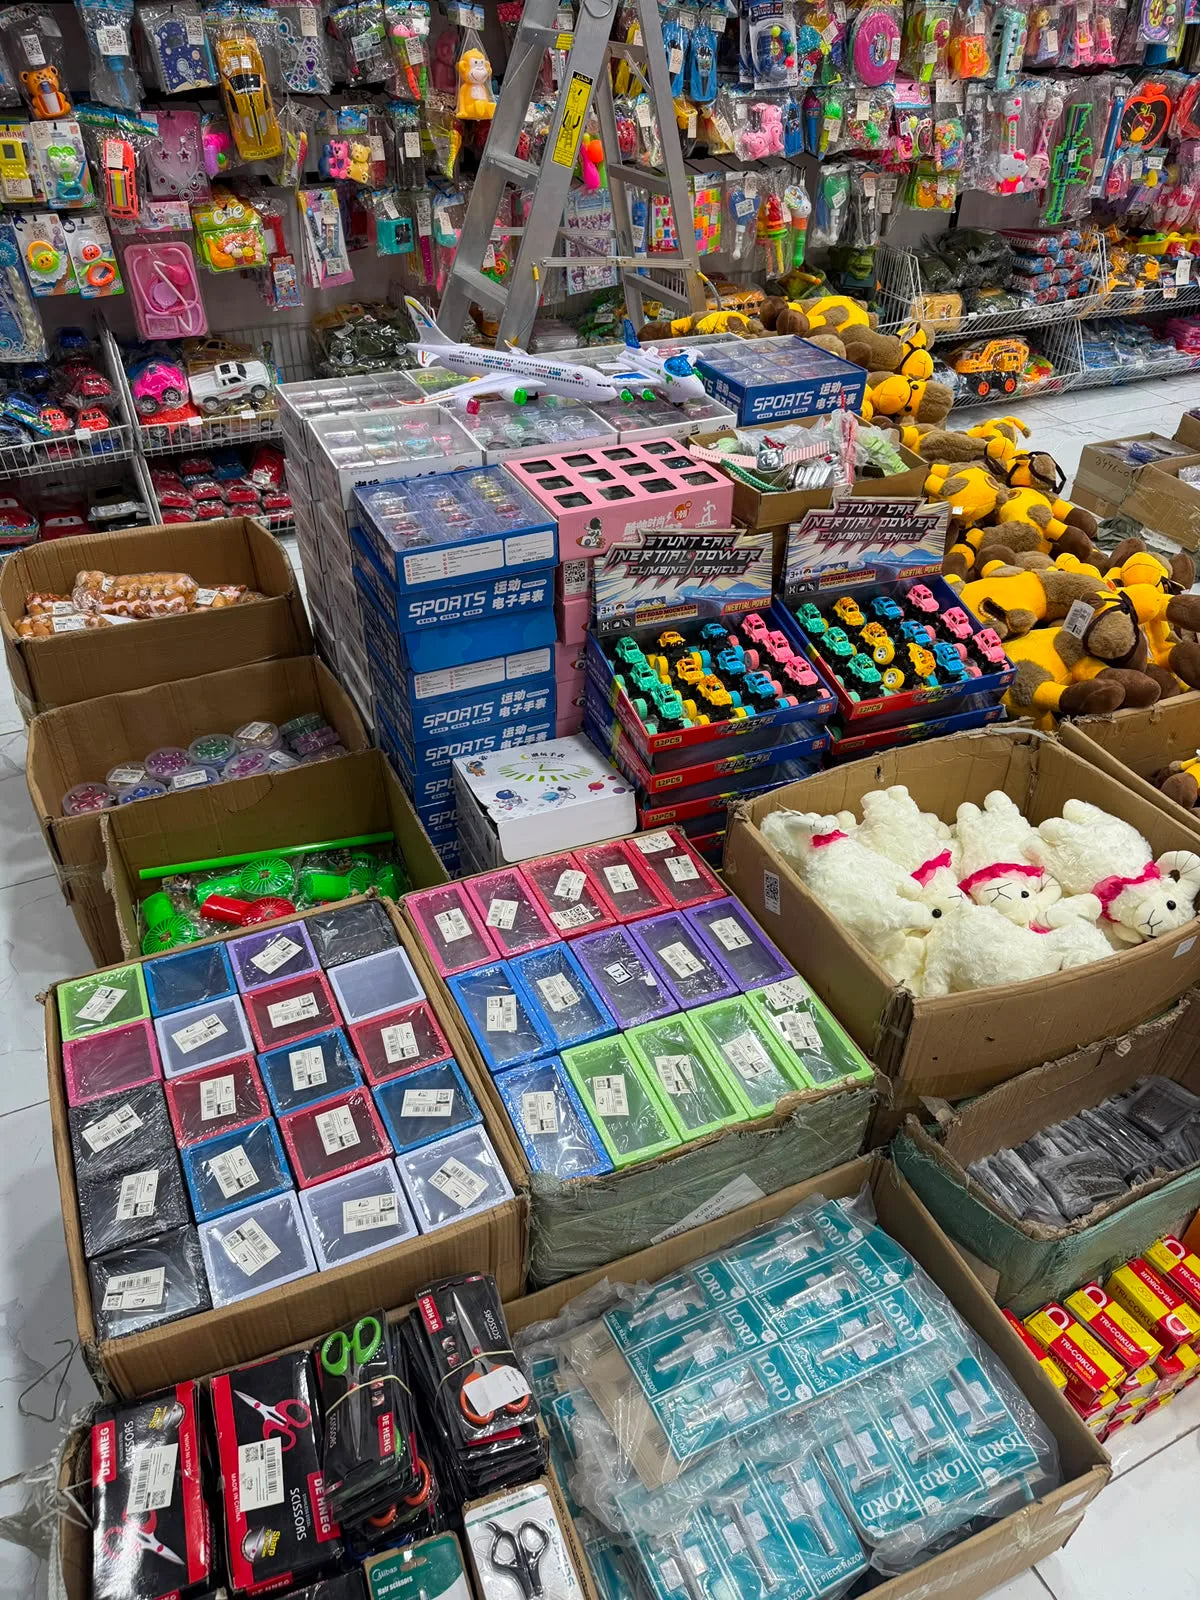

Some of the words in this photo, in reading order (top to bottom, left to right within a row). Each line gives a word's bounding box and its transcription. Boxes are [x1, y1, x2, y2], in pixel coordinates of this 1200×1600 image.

[752, 391, 815, 412] SPORTS
[819, 381, 843, 396] 运动
[838, 503, 888, 515] STUNT
[887, 503, 916, 515] CAR
[803, 516, 873, 530] INERTIAL
[877, 516, 938, 529] POWER
[645, 535, 696, 548] STUNT
[700, 535, 735, 548] CAR
[819, 532, 873, 541] CLIMBING
[877, 532, 924, 541] VEHICLE
[608, 549, 689, 564] INERTIAL
[690, 549, 763, 563] POWER
[629, 565, 689, 576] CLIMBING
[693, 565, 747, 575] VEHICLE
[901, 568, 924, 578] INERTIAL
[925, 565, 942, 574] POWER
[492, 589, 545, 610] 电子手表
[493, 578, 522, 595] 运动
[408, 591, 487, 618] SPORTS
[725, 600, 750, 613] INERTIAL
[750, 598, 771, 609] POWER
[499, 698, 547, 718] 电子手表
[501, 689, 526, 705] 运动
[422, 702, 495, 729] SPORTS
[502, 724, 527, 739] 运动
[655, 736, 681, 747] 12PCS
[424, 736, 496, 762] SPORTS
[656, 776, 681, 787] 12PCS
[814, 1211, 845, 1247] LORD
[847, 1252, 881, 1289] LORD
[1178, 1266, 1200, 1291] TRI-CO
[697, 1266, 728, 1302] LORD
[1140, 1270, 1175, 1306] TRI-COIKUR
[422, 1298, 436, 1319] HENG
[882, 1296, 918, 1342] LORD
[430, 1318, 439, 1330] DE
[484, 1309, 502, 1340] SCISSORS
[725, 1307, 758, 1346] LORD
[1100, 1315, 1141, 1353] TRI-COIKUR
[1060, 1337, 1097, 1376] TRI-COIKUR
[633, 1357, 647, 1376] PIECE
[644, 1373, 658, 1394] RAZOR
[756, 1353, 791, 1402] LORD
[149, 1407, 161, 1429] Sharp
[329, 1413, 337, 1449] SCISSORS
[382, 1414, 390, 1427] DE
[102, 1427, 110, 1461] HNEG
[124, 1420, 135, 1469] SCISSORS
[383, 1427, 392, 1453] HENG
[975, 1431, 1028, 1463] LORD
[314, 1478, 324, 1496] DE
[919, 1457, 970, 1491] LORD
[290, 1487, 307, 1541] SCISSORS
[860, 1482, 911, 1521] LORD
[317, 1497, 331, 1534] HNEG
[268, 1530, 280, 1557] Sharp
[821, 1564, 843, 1585] PIECE
[841, 1552, 865, 1570] RAZOR
[377, 1582, 390, 1596] Hair
[389, 1575, 414, 1592] scissors
